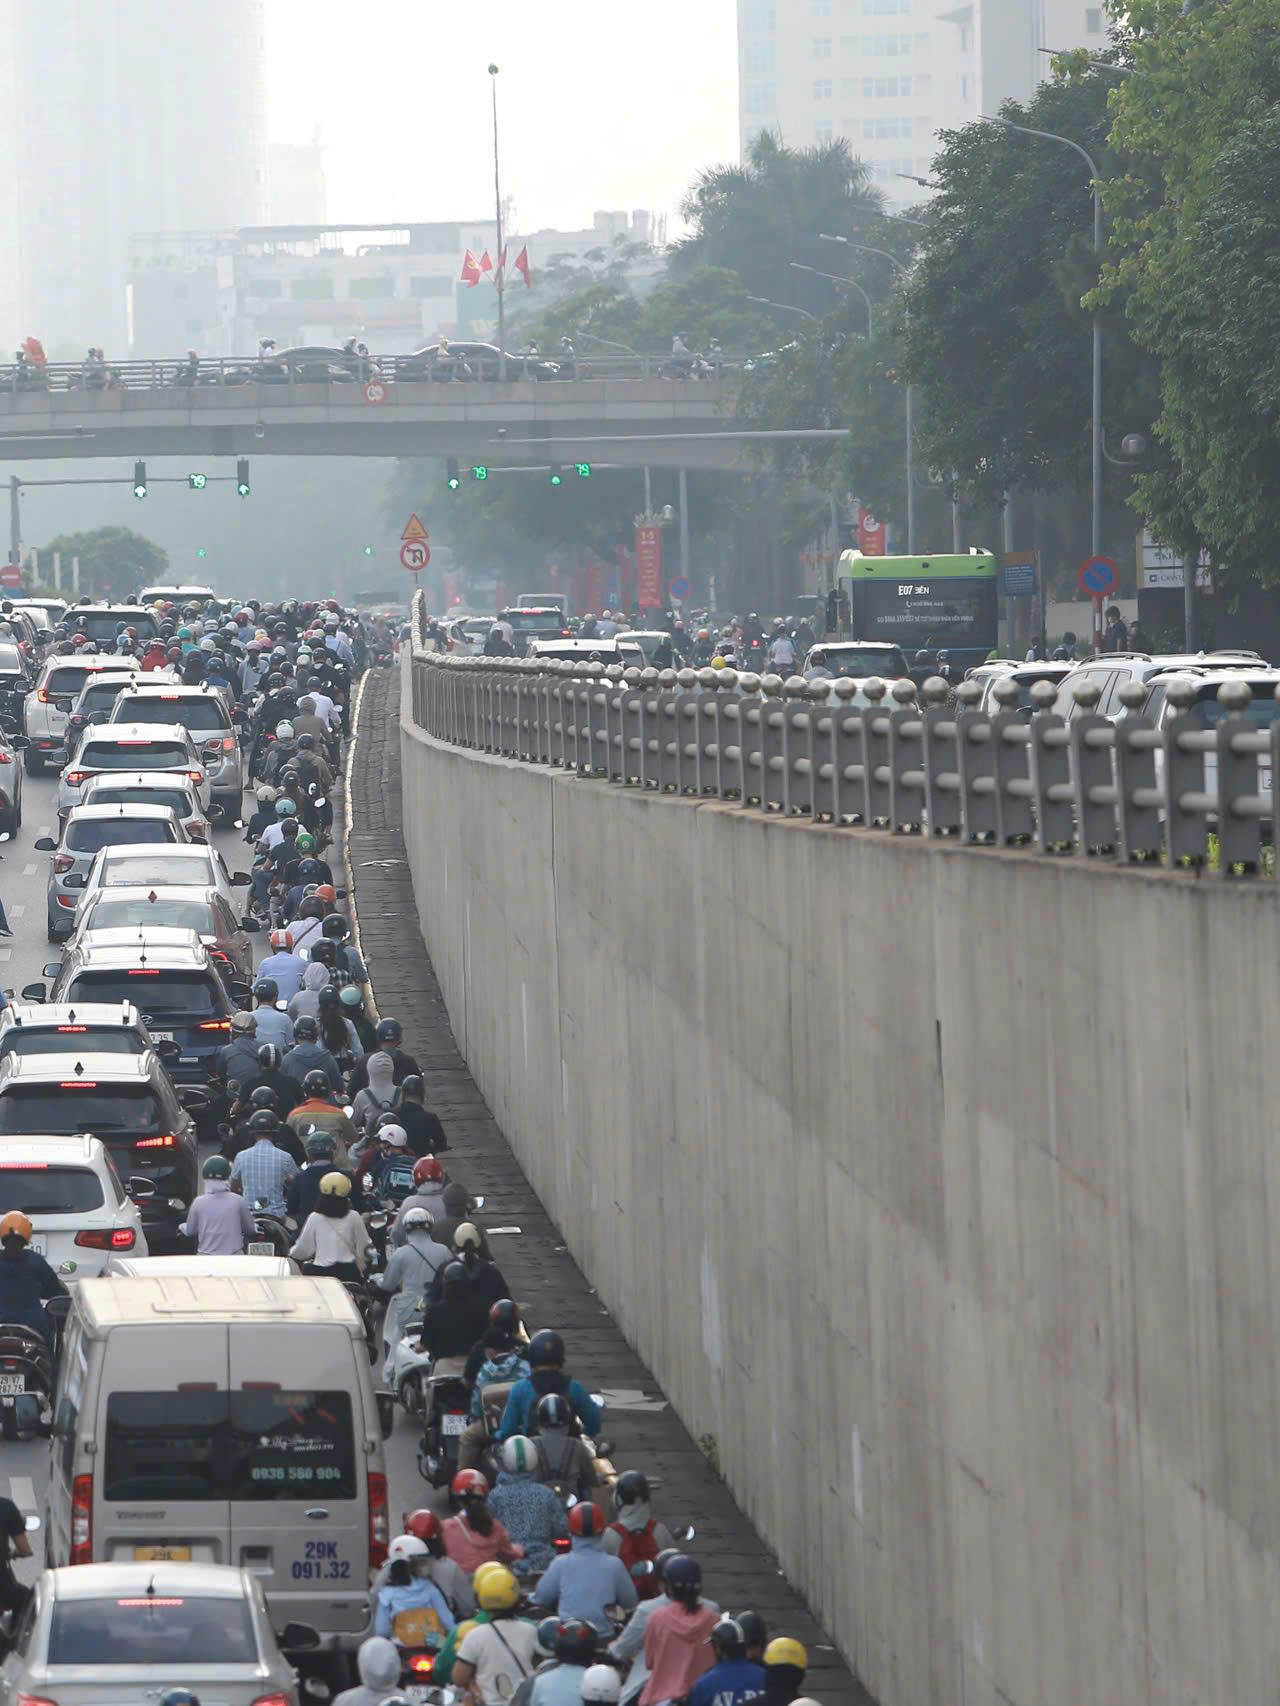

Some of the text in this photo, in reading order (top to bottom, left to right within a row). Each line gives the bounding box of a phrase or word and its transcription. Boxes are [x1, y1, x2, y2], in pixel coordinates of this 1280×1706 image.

[898, 585, 914, 595] E07
[305, 1541, 338, 1559] 29K
[292, 1561, 351, 1580] 091.32
